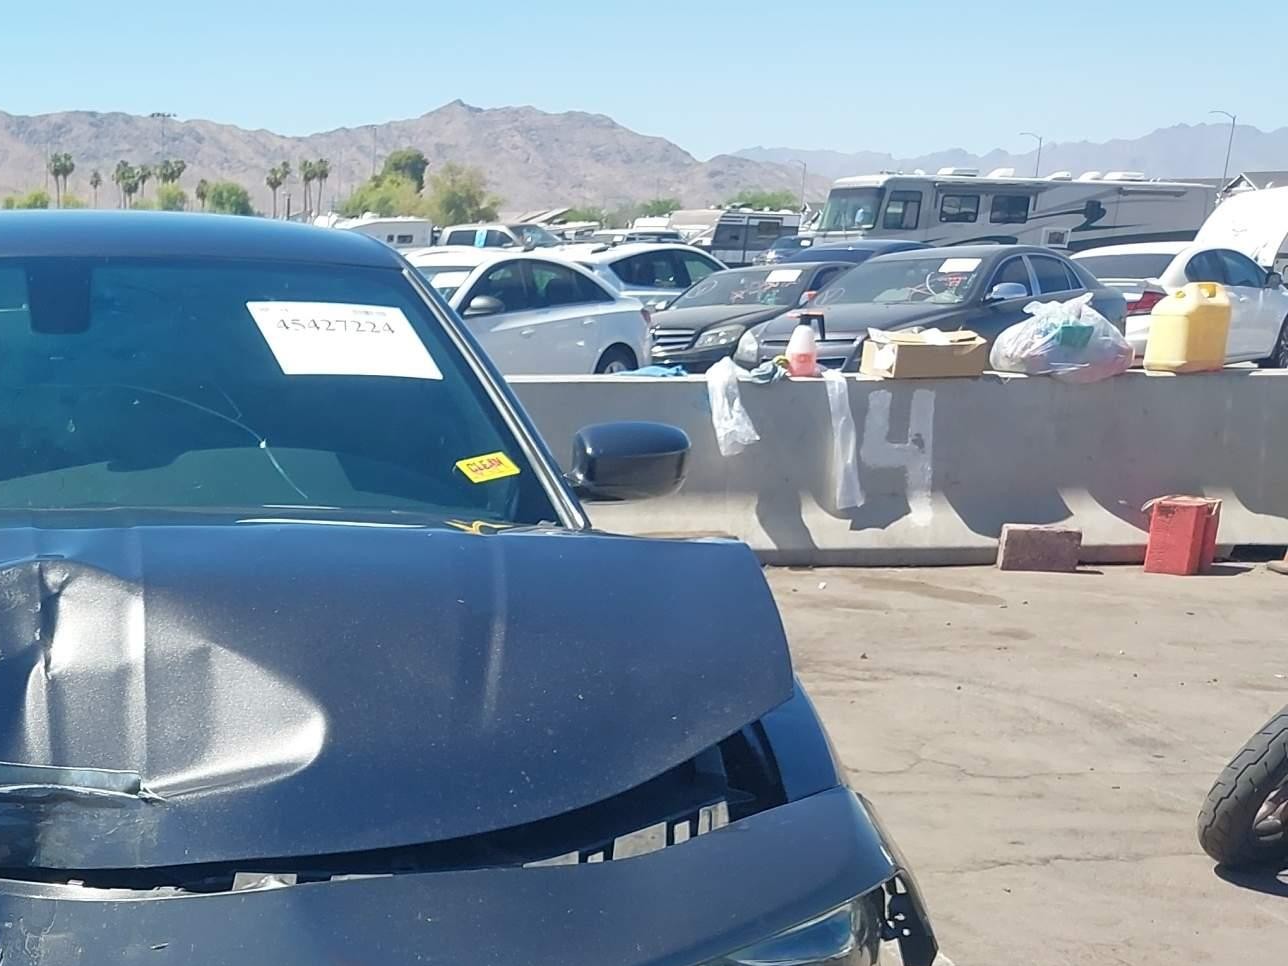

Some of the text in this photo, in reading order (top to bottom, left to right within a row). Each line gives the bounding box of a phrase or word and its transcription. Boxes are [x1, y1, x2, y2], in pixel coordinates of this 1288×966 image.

[276, 319, 395, 334] 45427224
[466, 457, 505, 473] CLEAN
[860, 388, 936, 526] 4
